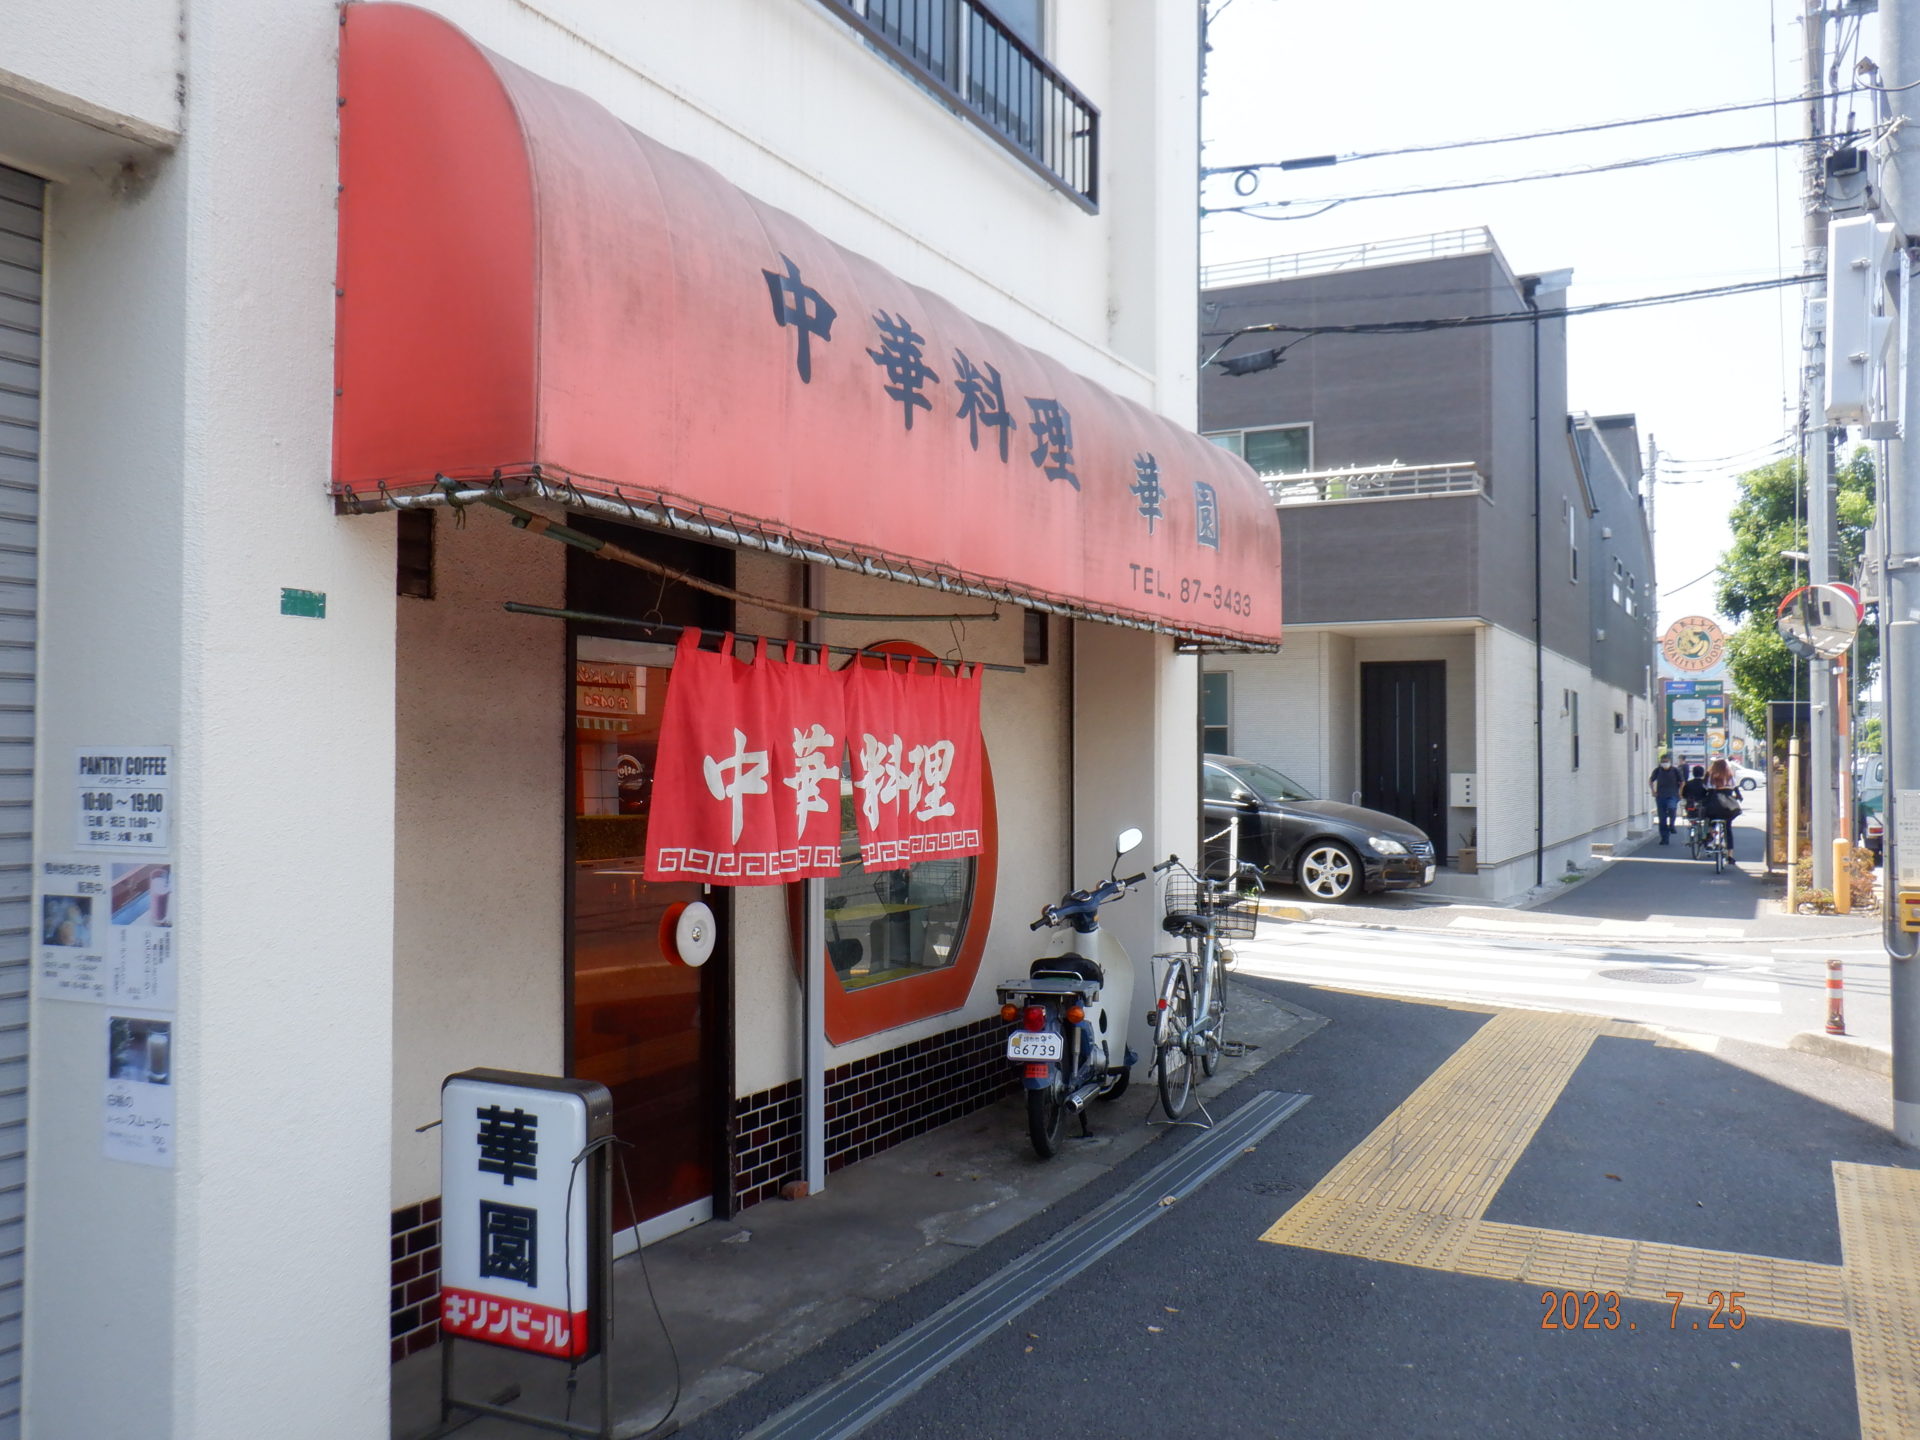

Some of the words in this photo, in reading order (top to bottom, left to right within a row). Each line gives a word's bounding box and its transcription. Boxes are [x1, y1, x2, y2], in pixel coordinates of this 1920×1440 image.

[762, 252, 1080, 491] 中華料理
[1129, 563, 1171, 600] TEL.
[1180, 577, 1251, 617] 87-3433
[80, 756, 123, 775] PANTRY
[126, 756, 167, 776] COFFEE
[703, 723, 955, 846] 中華料理
[477, 1105, 538, 1288] 華園
[445, 1295, 570, 1347] キリンビール
